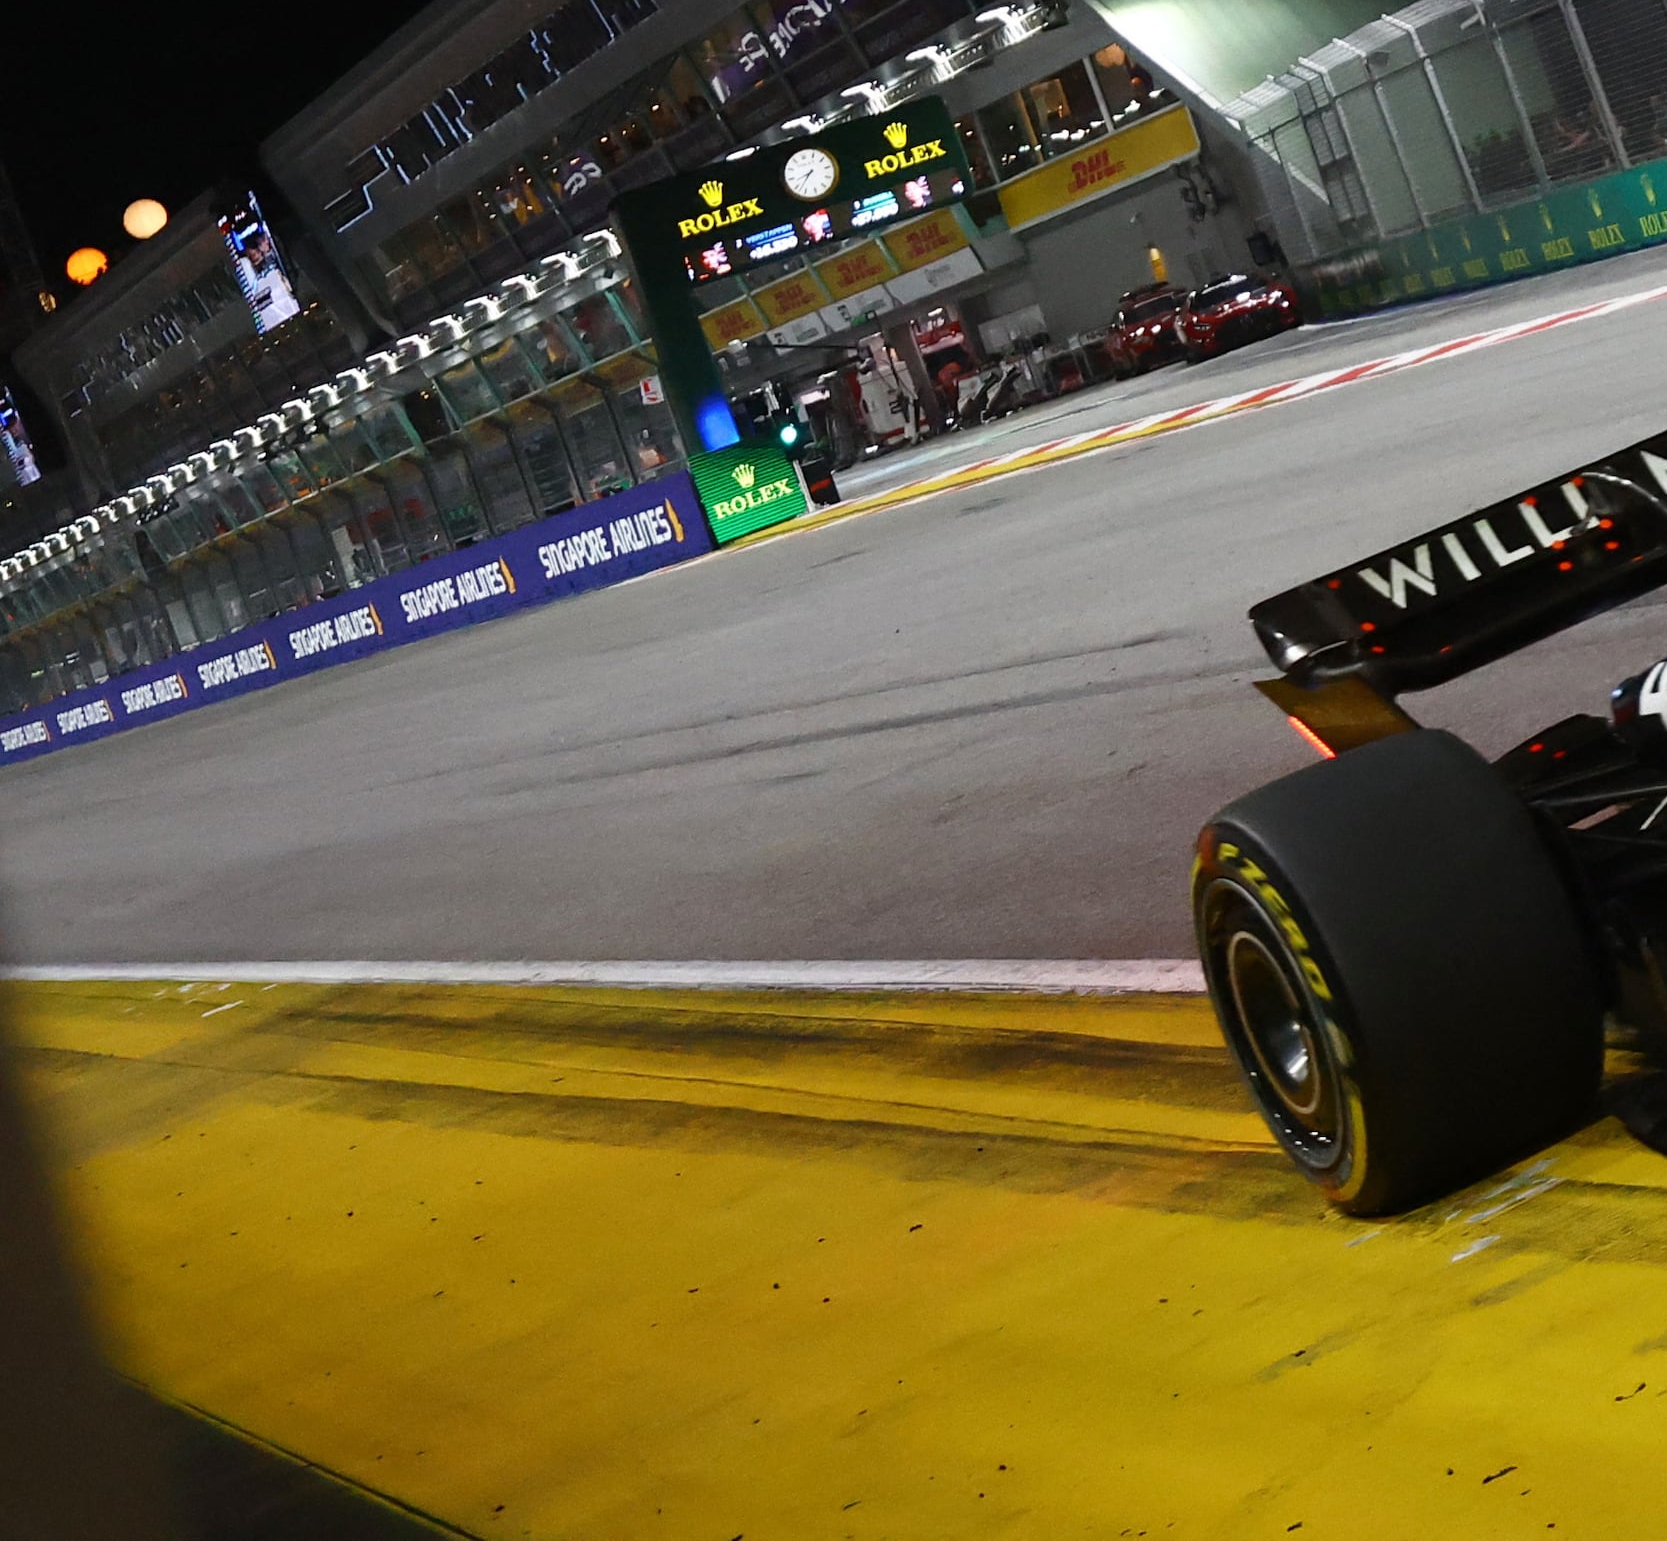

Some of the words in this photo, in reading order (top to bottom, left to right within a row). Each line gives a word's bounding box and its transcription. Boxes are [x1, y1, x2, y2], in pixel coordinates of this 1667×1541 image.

[864, 139, 947, 179] ROLEX
[1068, 150, 1126, 193] DHL
[678, 197, 764, 239] ROLEX
[1587, 222, 1625, 249] ROLEX
[712, 476, 793, 520] ROLEX
[538, 527, 611, 579] SINGAPORE
[608, 506, 672, 559] AIRLINES
[400, 577, 458, 623] SINGAPORE
[457, 563, 507, 607] AIRLINES
[289, 620, 337, 659] SINGAPORE
[335, 607, 375, 643] AIRLINES
[197, 654, 239, 689] SINGAPORE
[234, 643, 270, 678] AIRLINES
